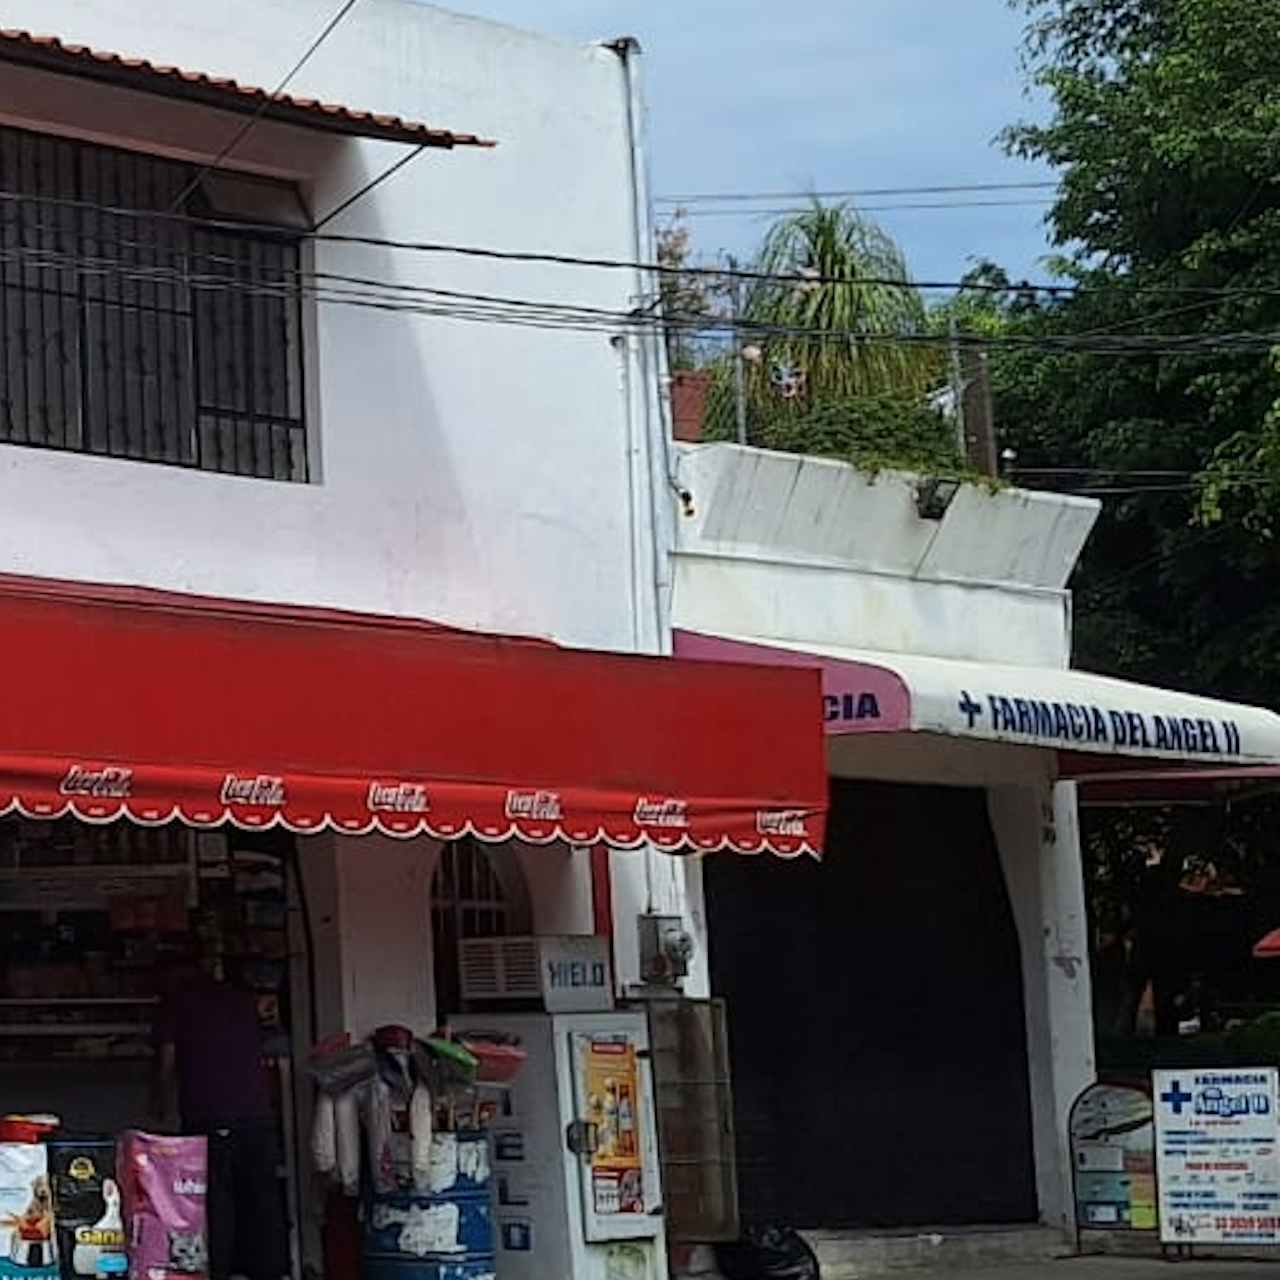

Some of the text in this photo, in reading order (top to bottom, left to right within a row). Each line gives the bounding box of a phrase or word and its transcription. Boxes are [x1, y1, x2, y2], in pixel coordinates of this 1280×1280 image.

[822, 693, 881, 720] CIA
[987, 695, 1240, 756] FARMACIA DEL ANGEL II
[495, 1089, 532, 1251] IELO
